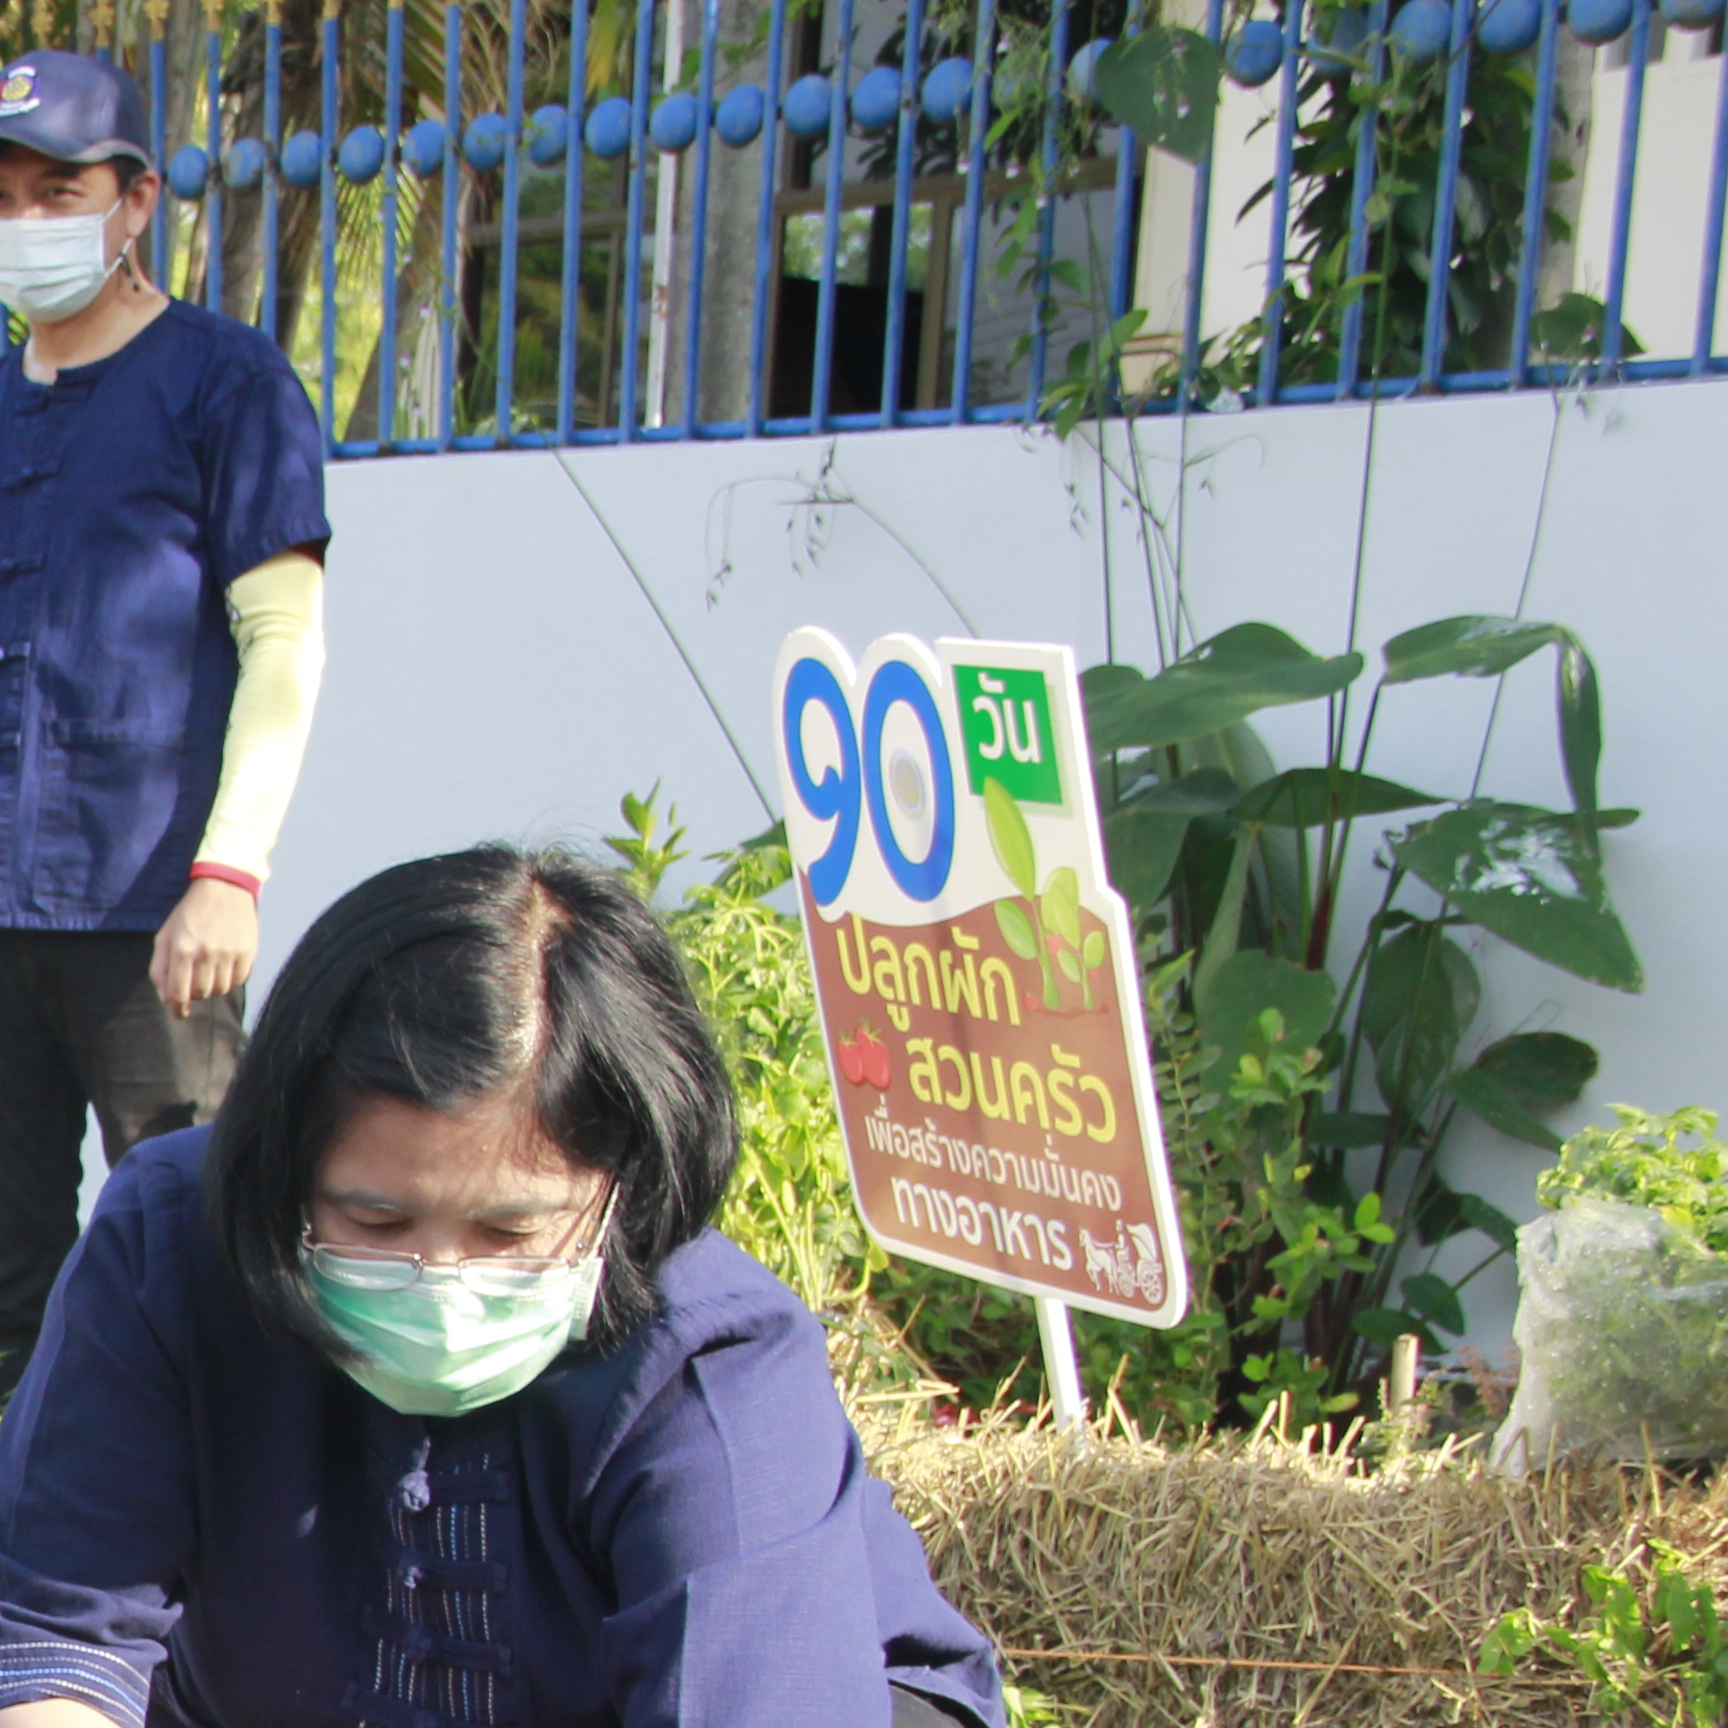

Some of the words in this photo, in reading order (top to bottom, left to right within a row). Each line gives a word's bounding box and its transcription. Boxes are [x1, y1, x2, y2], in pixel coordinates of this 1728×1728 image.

[972, 671, 1042, 764] วัน
[836, 913, 1021, 1032] ปลูกผัก
[905, 1038, 1117, 1143] สวนครัว
[864, 1094, 1122, 1212] เพื่อสร้างความมั่นคง
[891, 1177, 1073, 1271] ทางอาหาร
